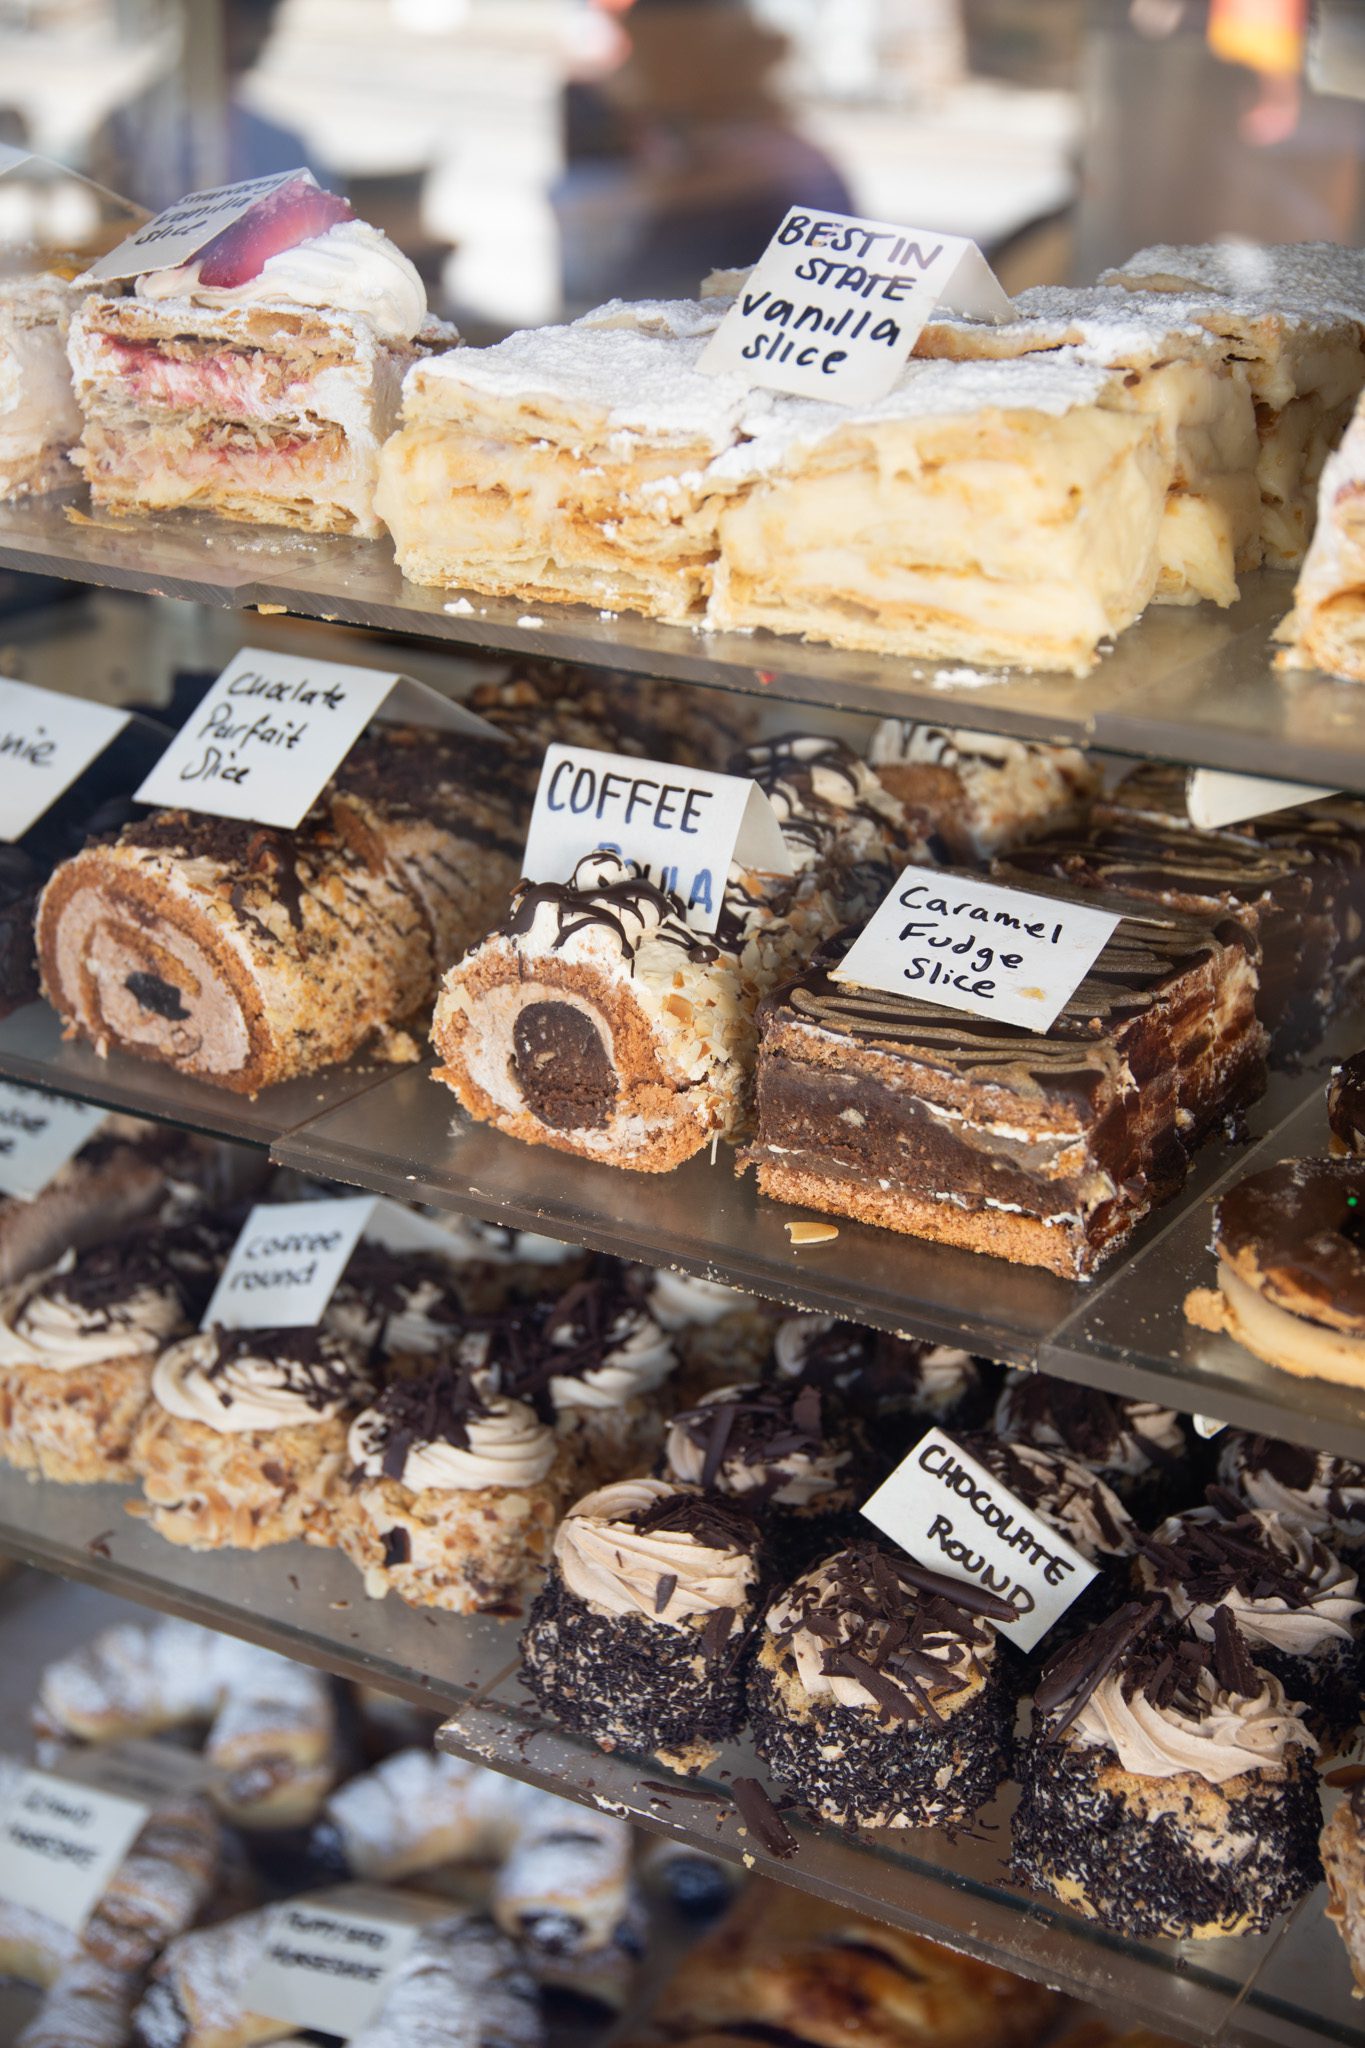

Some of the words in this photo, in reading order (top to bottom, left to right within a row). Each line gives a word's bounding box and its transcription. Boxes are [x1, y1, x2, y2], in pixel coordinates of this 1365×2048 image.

[153, 196, 253, 227] vanilla
[777, 215, 897, 258] BEST
[887, 237, 945, 270] IN
[795, 257, 918, 302] STATE
[741, 291, 902, 347] vanilla
[741, 331, 848, 375] slice
[198, 702, 308, 749] Parfait
[547, 760, 714, 834] COFFEE
[899, 885, 1064, 944] Caramel
[899, 922, 1024, 973] Fudge
[918, 1443, 1076, 1586] CHOCOLATE
[926, 1513, 1036, 1615] ROUND
